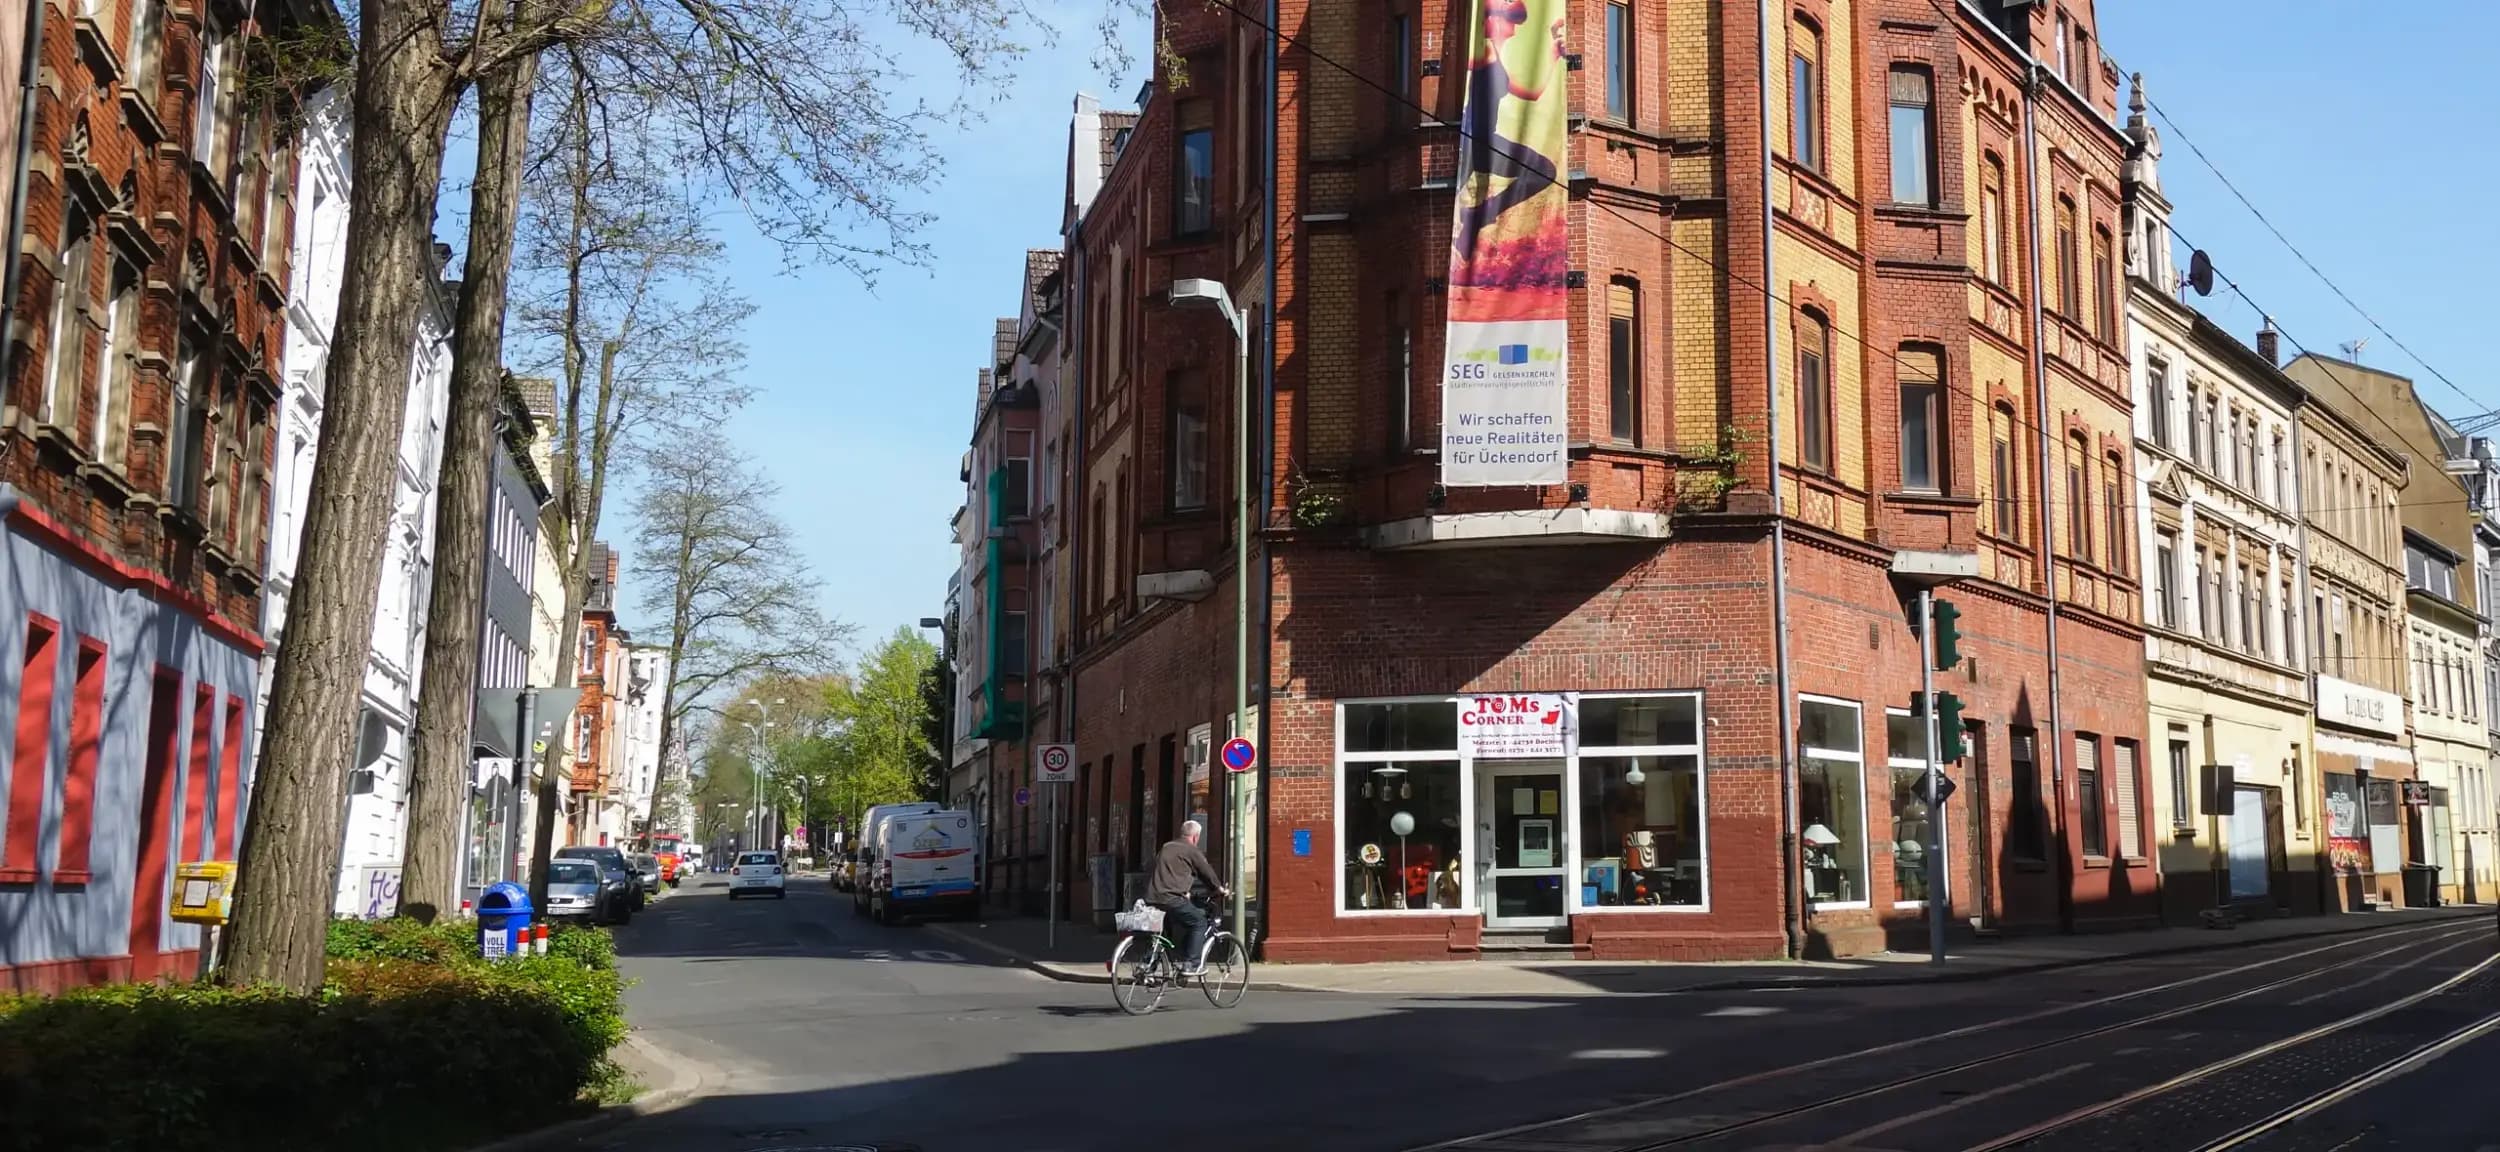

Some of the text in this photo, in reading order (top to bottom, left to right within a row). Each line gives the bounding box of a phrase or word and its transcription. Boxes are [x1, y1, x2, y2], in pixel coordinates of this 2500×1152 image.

[1451, 364, 1485, 379] SEG
[1459, 412, 1553, 426] Wir schaffen
[1446, 431, 1564, 445] neue Realitäten
[1452, 448, 1559, 464] für Ückendorf
[1048, 753, 1065, 765] 30
[1046, 772, 1066, 780] ZONE
[486, 936, 505, 946] VOLL
